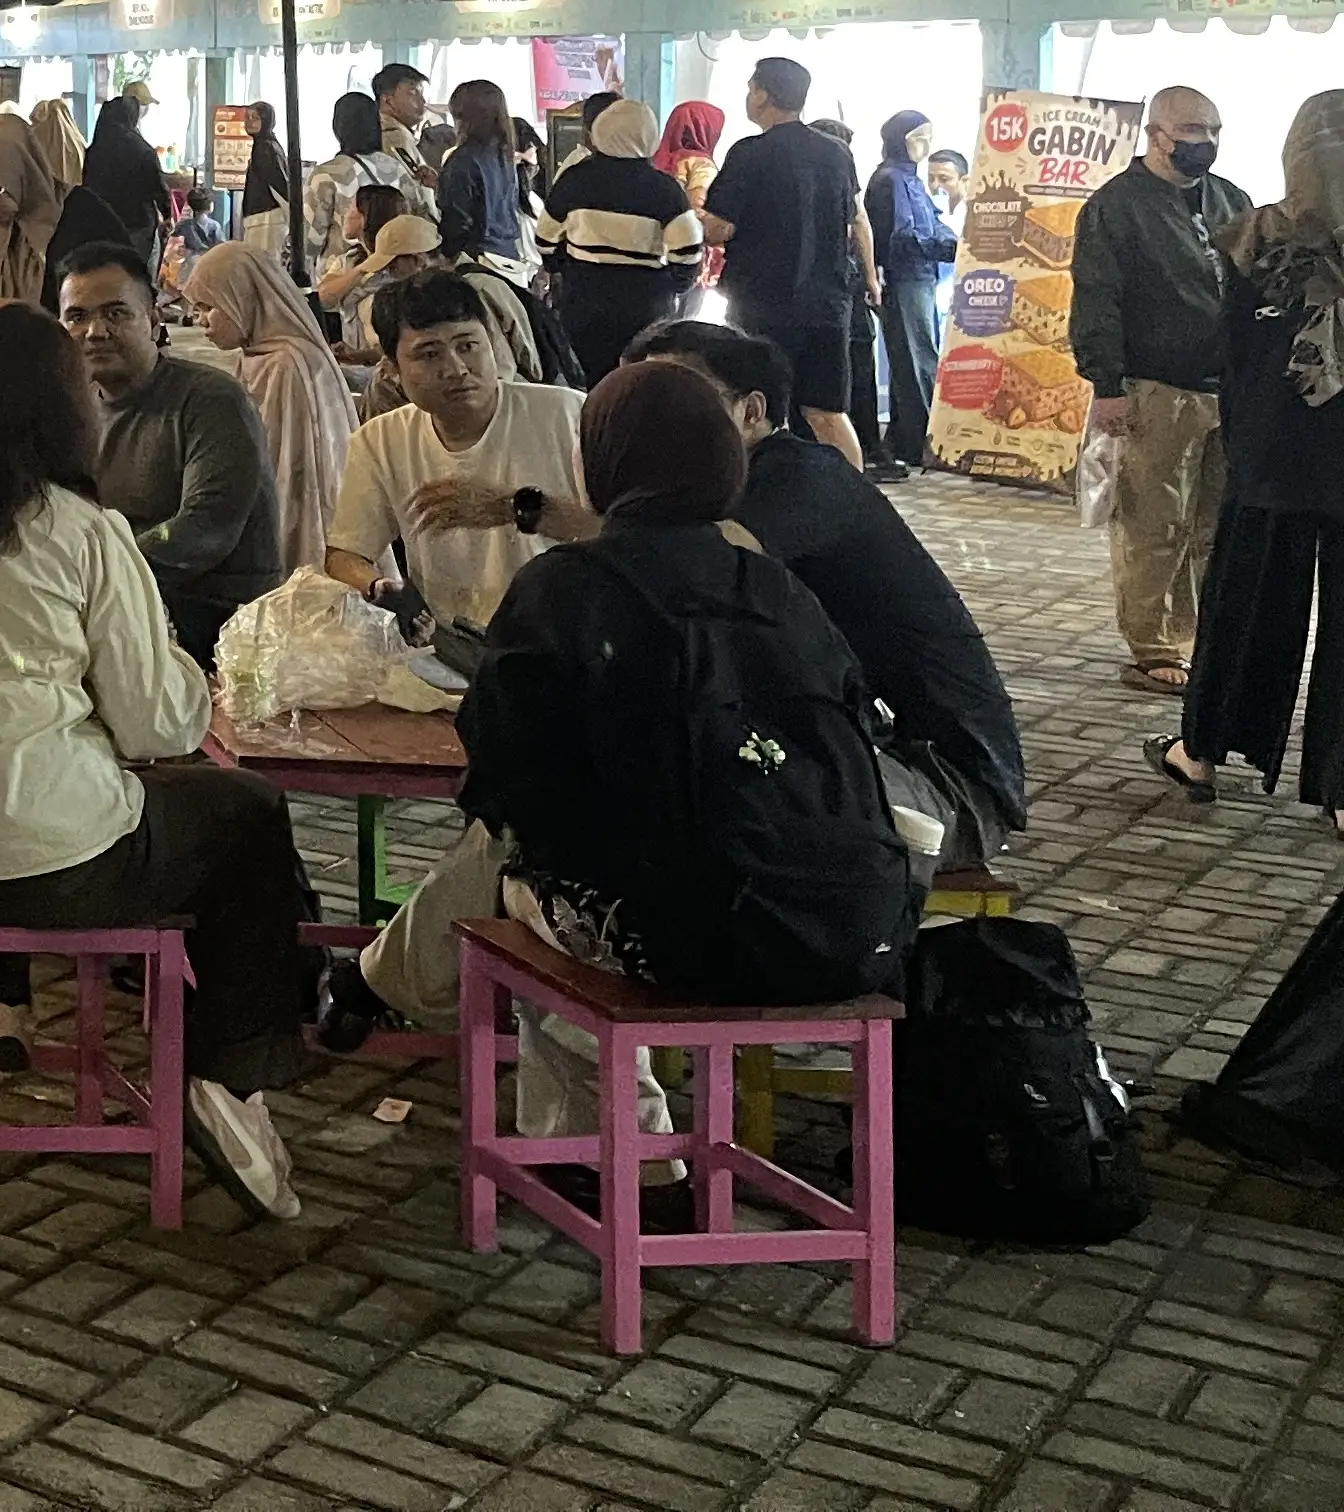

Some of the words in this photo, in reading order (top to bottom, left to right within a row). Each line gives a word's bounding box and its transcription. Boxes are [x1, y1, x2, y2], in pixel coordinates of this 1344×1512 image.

[990, 115, 1024, 142] 15K
[1042, 109, 1061, 123] ICE
[1064, 110, 1101, 128] CREAM
[1028, 125, 1117, 166] GABIN
[1038, 158, 1090, 185] BAR
[963, 278, 1005, 294] OREO
